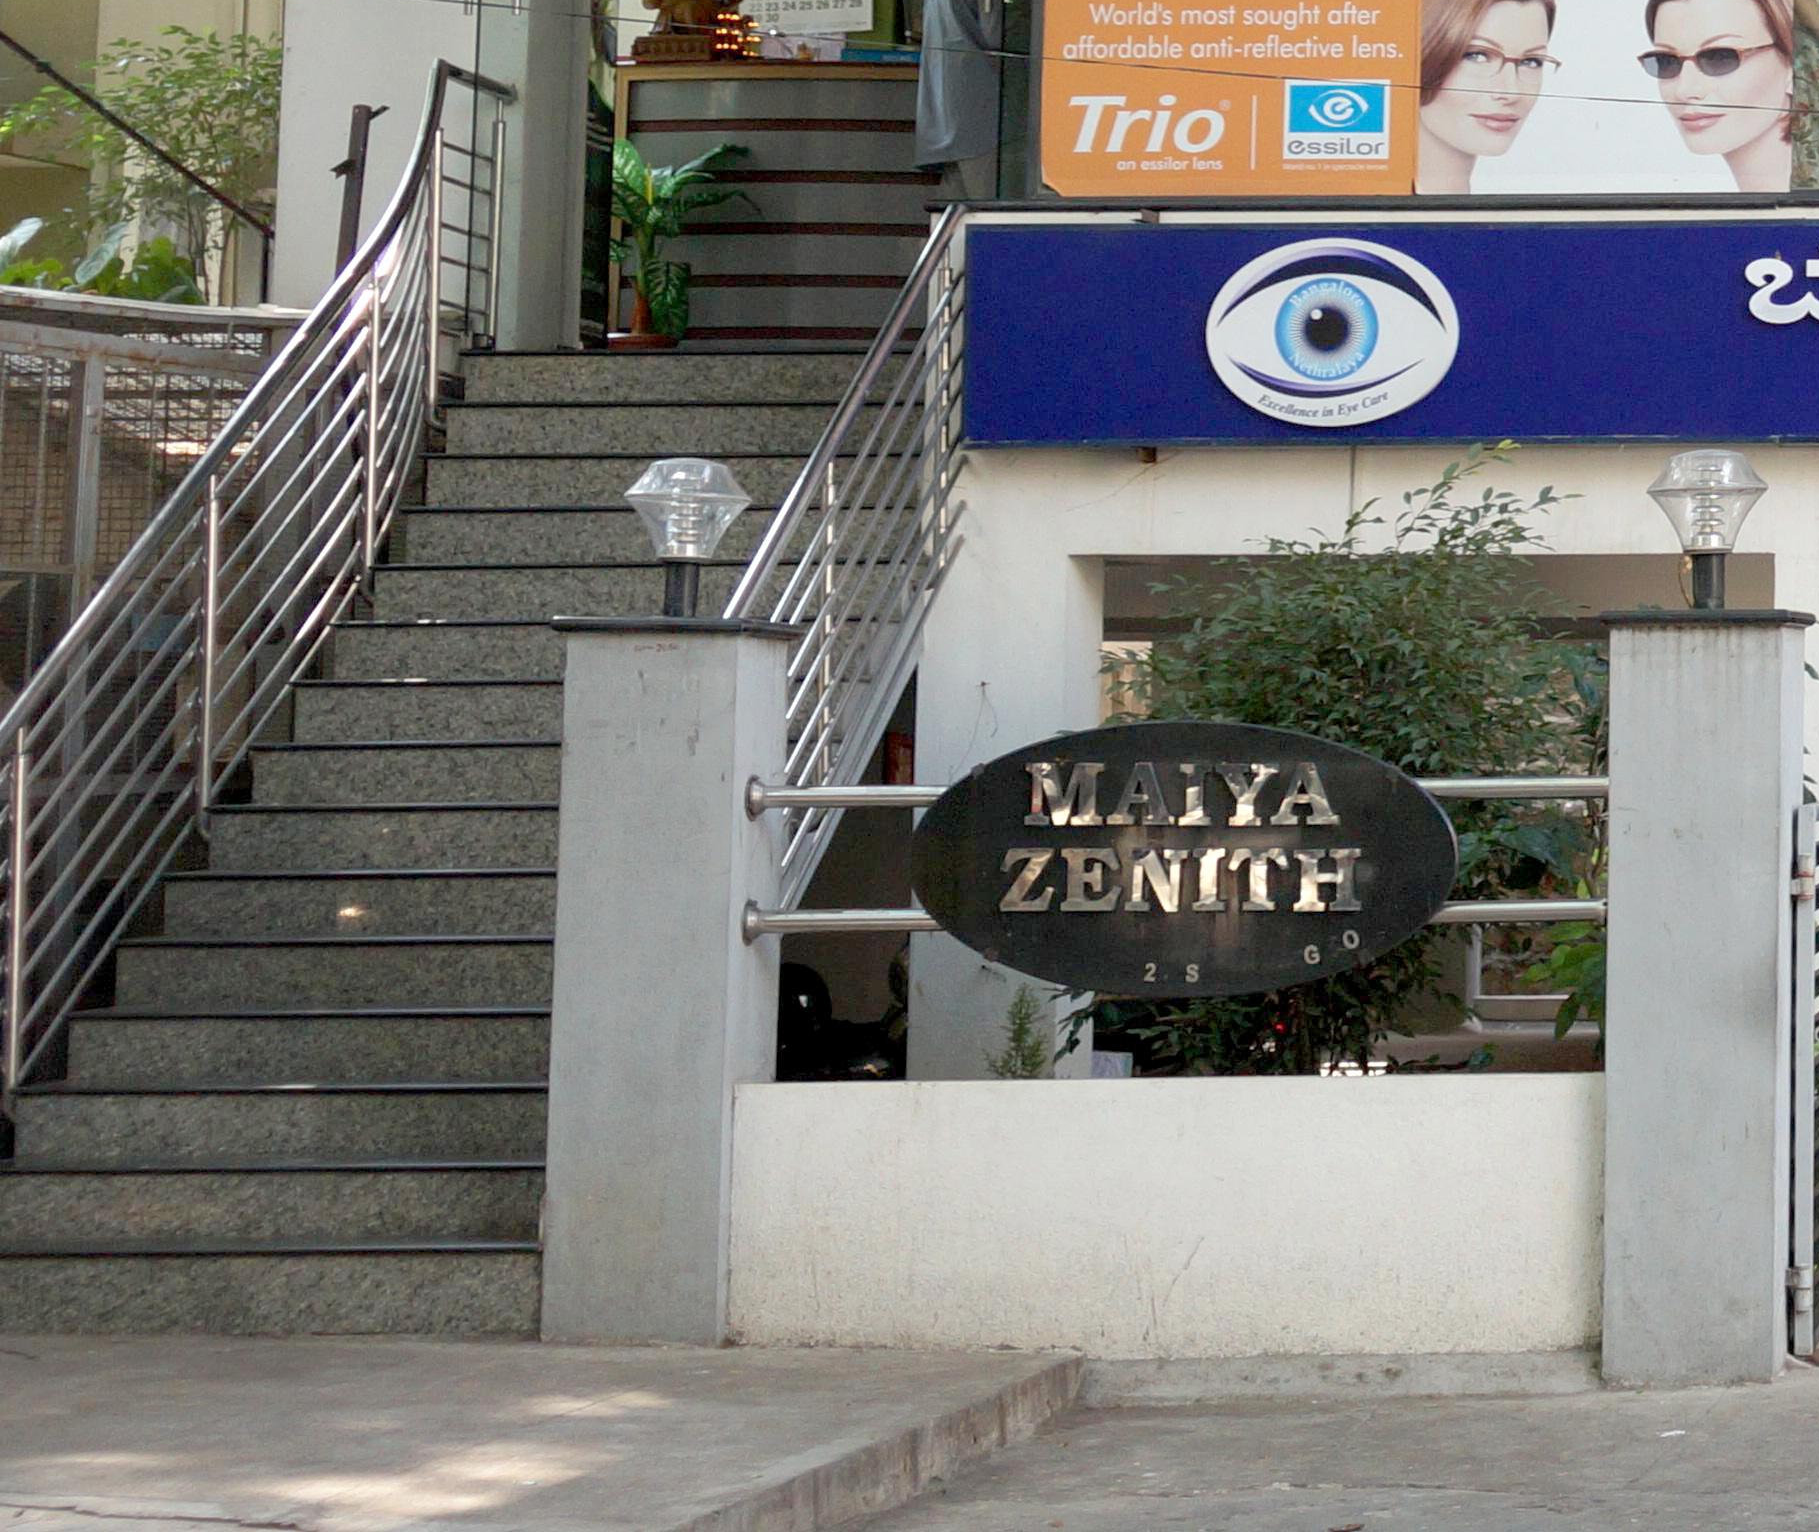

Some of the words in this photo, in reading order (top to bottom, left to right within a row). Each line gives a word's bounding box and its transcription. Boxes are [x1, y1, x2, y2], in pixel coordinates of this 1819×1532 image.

[1088, 1, 1174, 27] World's
[1180, 5, 1236, 27] most
[1242, 2, 1321, 30] sought
[1326, 1, 1381, 26] after
[1062, 34, 1184, 60] affordable
[1190, 34, 1345, 59] anti-reflective
[1351, 35, 1404, 59] lens.
[1068, 95, 1226, 154] Trio
[1116, 159, 1138, 171] an
[1140, 156, 1189, 171] essilor
[1192, 156, 1223, 170] lens
[1257, 393, 1320, 419] Excellence
[1321, 406, 1334, 417] in
[1337, 403, 1359, 419] Eye
[1360, 390, 1390, 409] Care
[1023, 761, 1342, 828] MAIYA
[999, 846, 1363, 914] ZENITH
